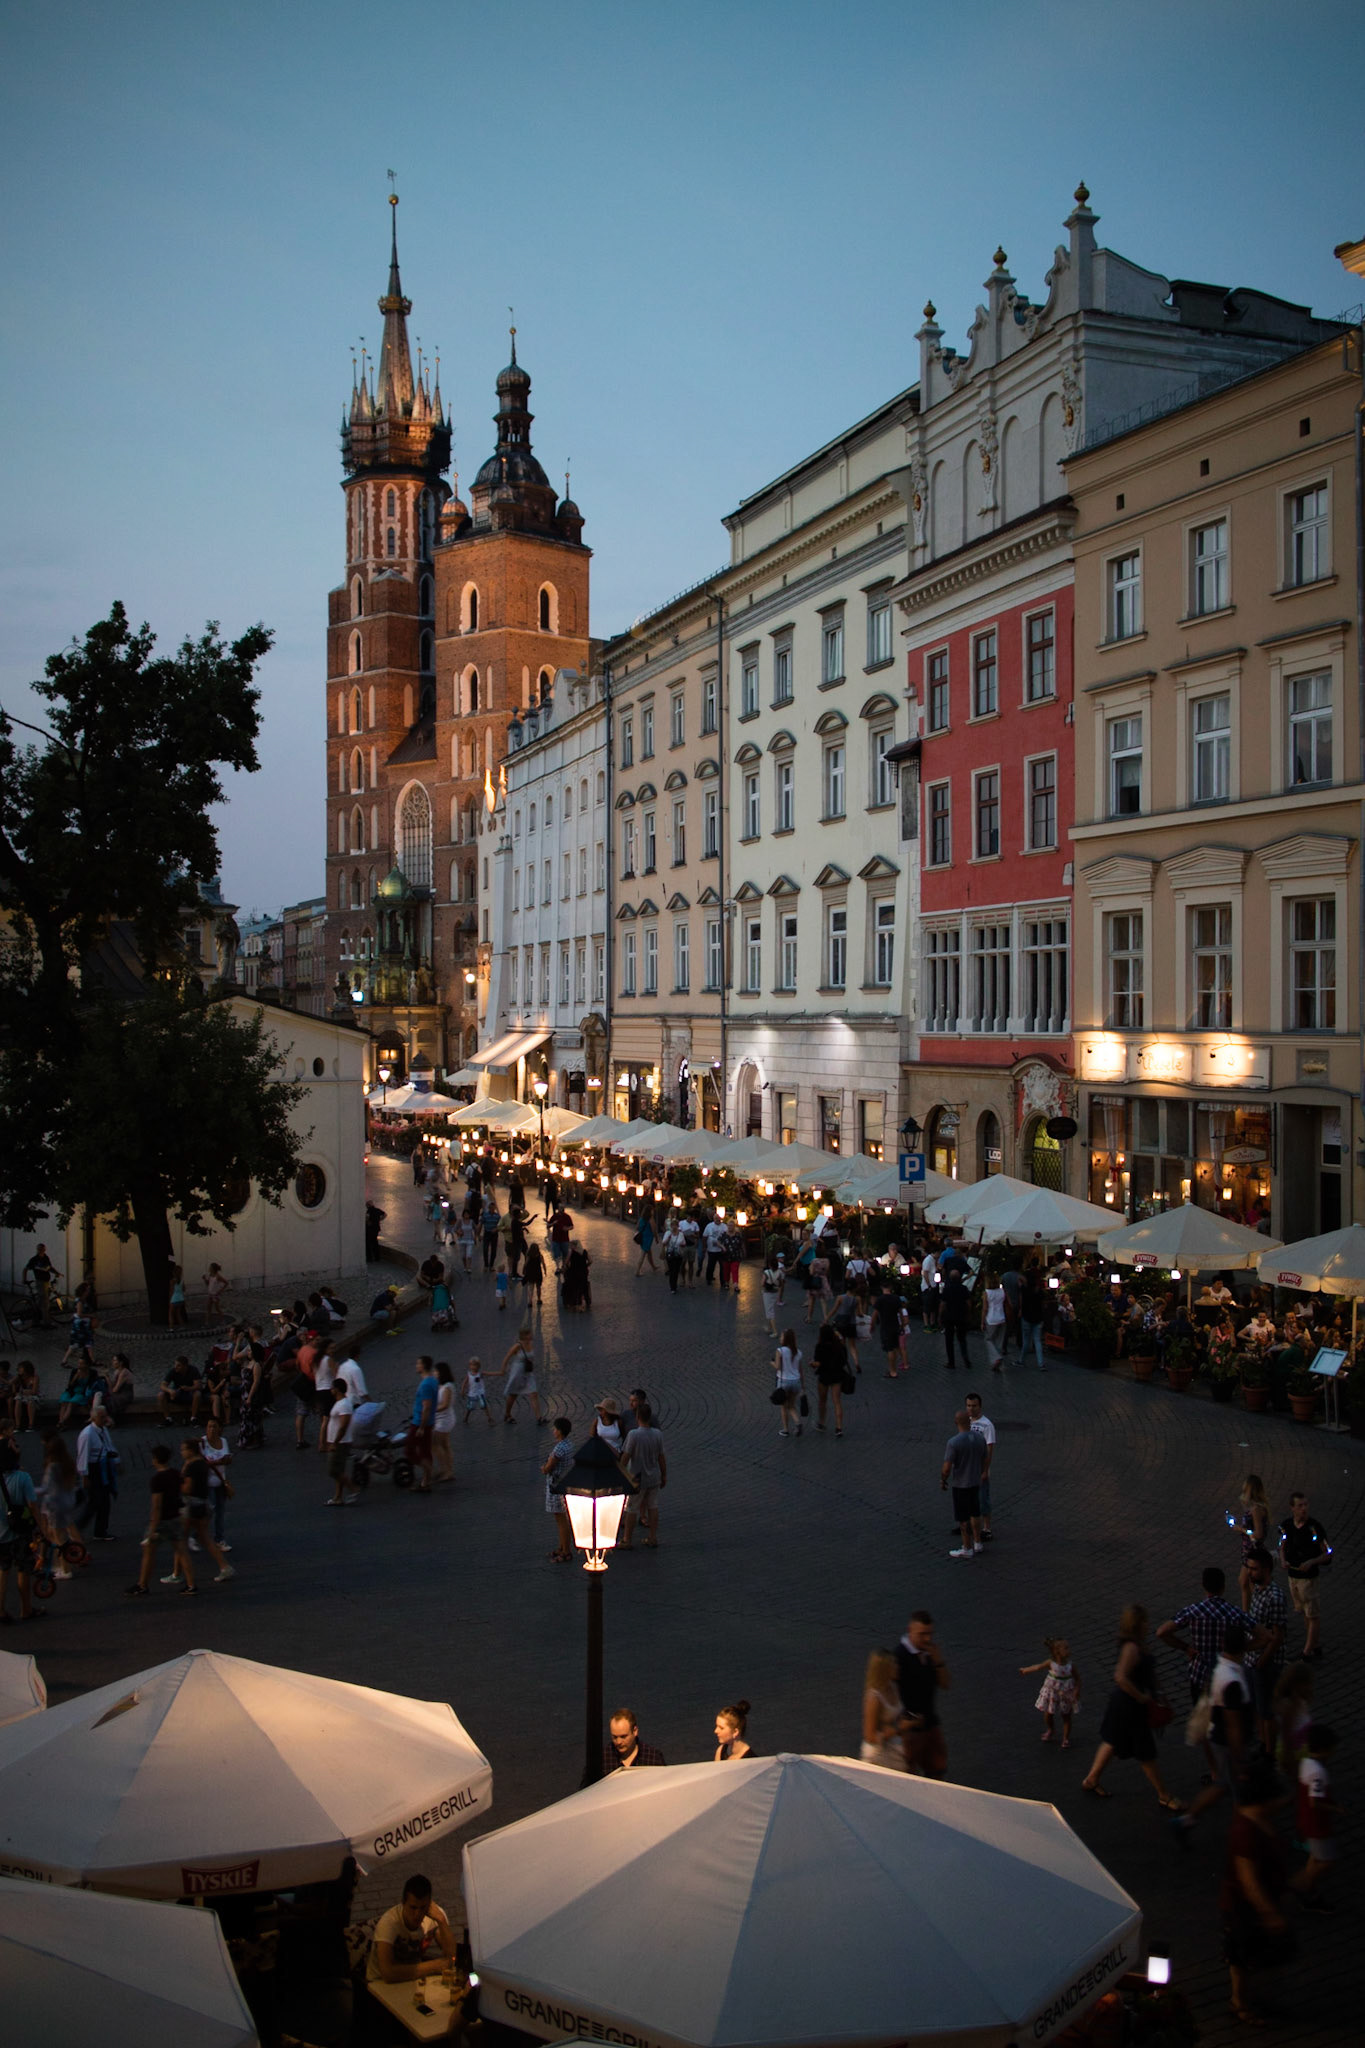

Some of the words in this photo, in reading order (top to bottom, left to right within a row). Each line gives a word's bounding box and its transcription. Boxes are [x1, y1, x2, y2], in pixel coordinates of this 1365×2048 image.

[904, 1156, 920, 1179] P
[373, 1810, 433, 1857] GRANDE
[439, 1787, 478, 1820] GRILL
[187, 1866, 254, 1892] TYSKIE
[504, 1989, 590, 2036] GRANDE
[1033, 1976, 1087, 2039] GRANDE
[1093, 1944, 1127, 1984] GRILL
